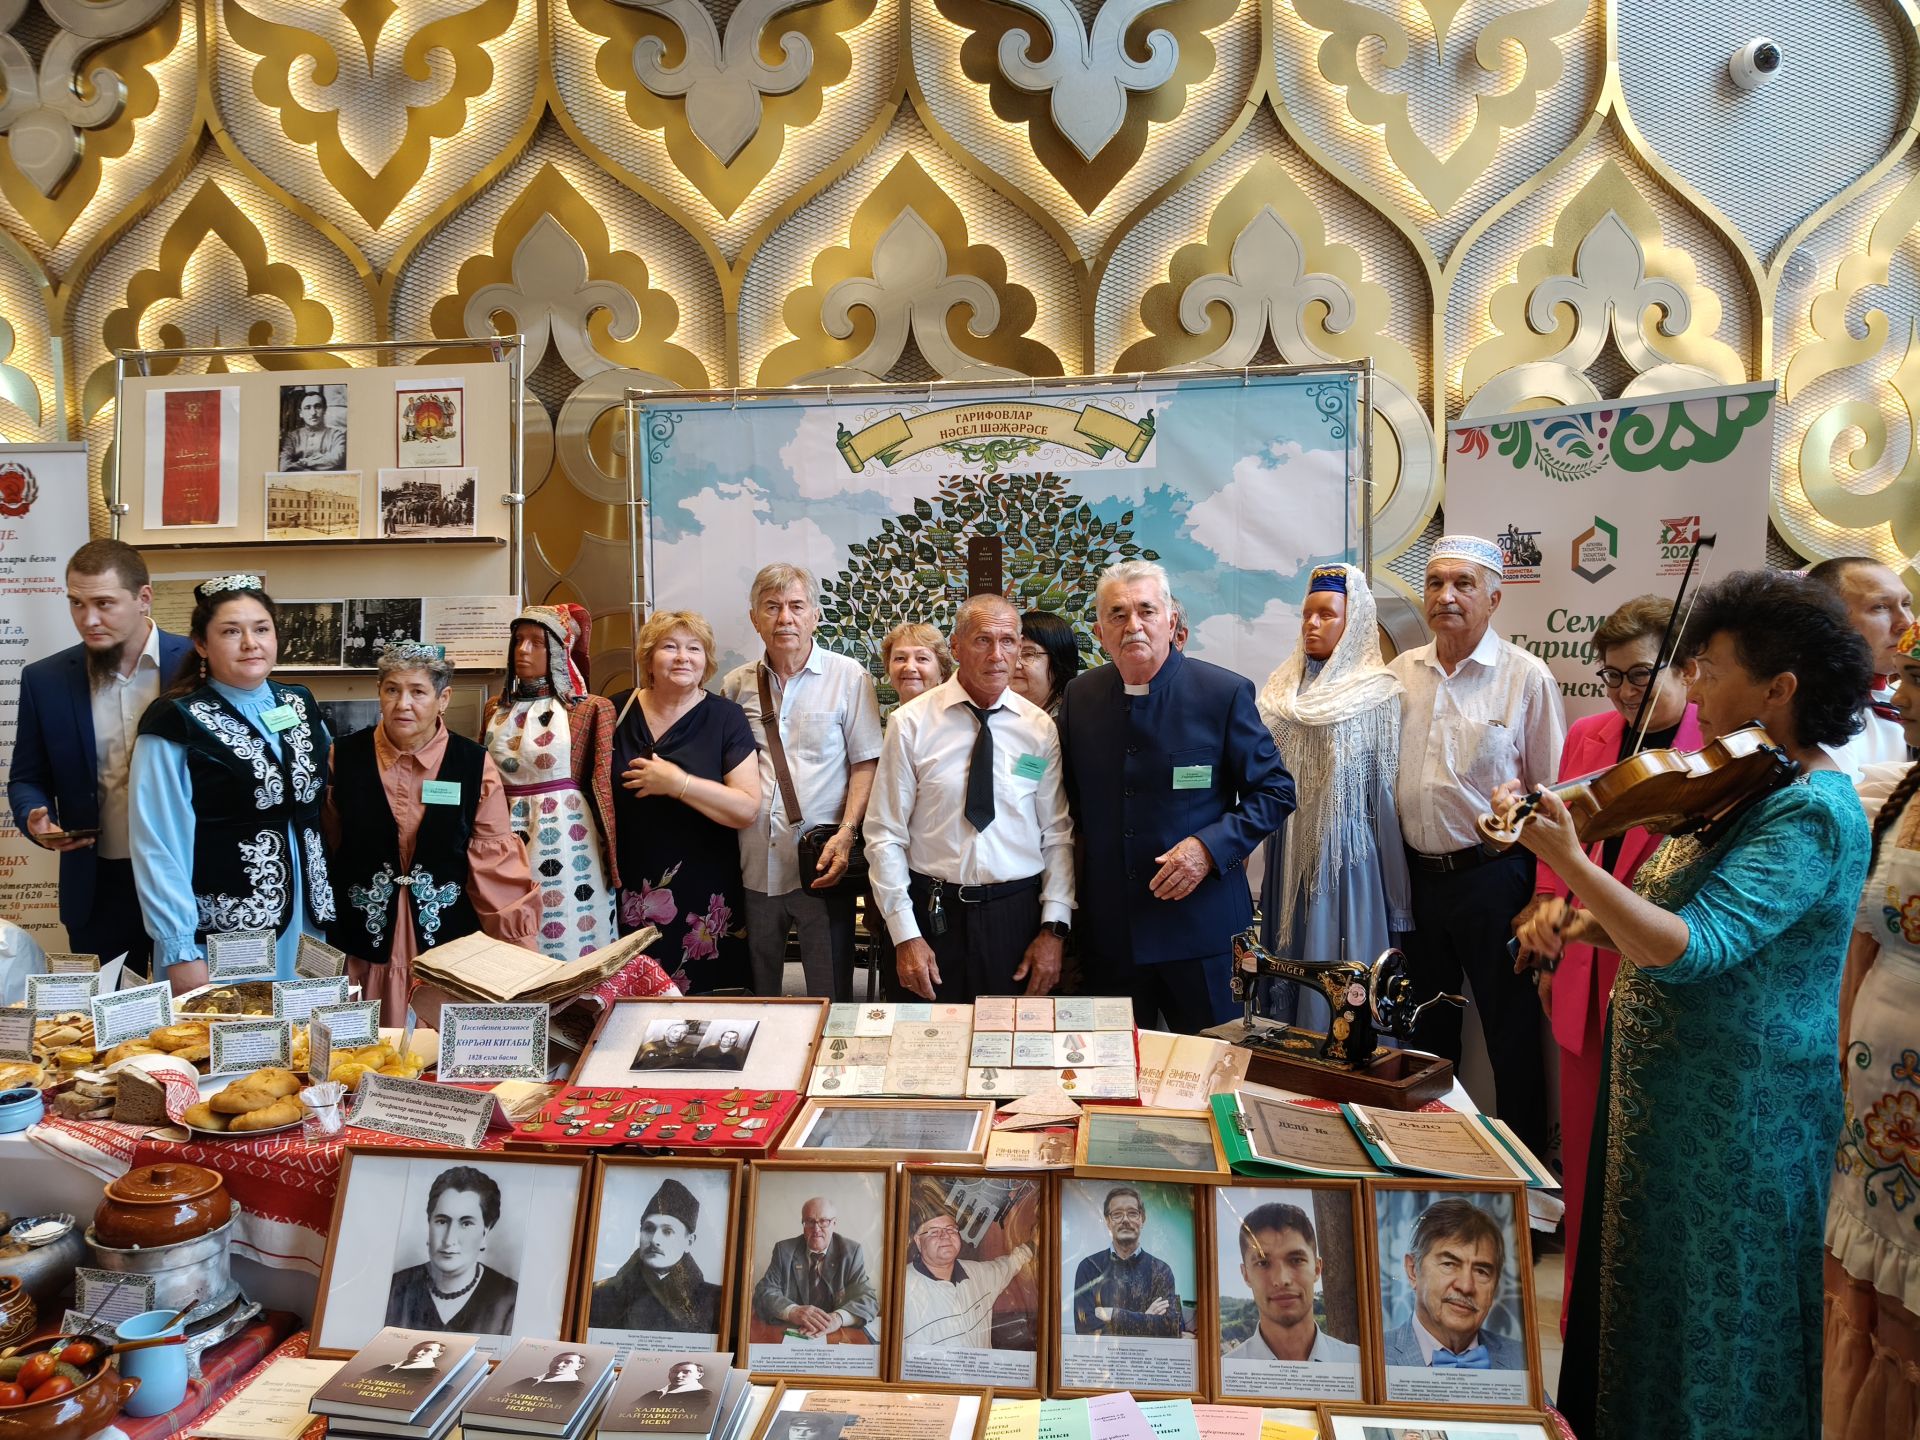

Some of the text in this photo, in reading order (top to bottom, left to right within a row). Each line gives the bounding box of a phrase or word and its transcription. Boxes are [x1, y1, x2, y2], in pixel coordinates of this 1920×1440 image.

[955, 410, 1033, 424] ГАРИФОВЛАР
[940, 423, 1049, 440] НӘСЕЛ ШӘҖӘРӘСЕ
[1497, 537, 1512, 551] 20
[1557, 682, 1610, 698] нск
[15, 891, 43, 901] (1620
[9, 901, 21, 910] 50
[1269, 961, 1305, 976] SINGER
[456, 1038, 531, 1047] КӨРЪӘН КИТАБЫ
[342, 1381, 415, 1396] КАЙТАРЫЛГАН
[359, 1378, 407, 1389] ХАЛЫККА
[358, 1390, 388, 1400] ИСЕМ
[505, 1392, 553, 1403] ХАЛЫККА
[487, 1396, 563, 1410] КАЙТАРЫЛГАН
[505, 1404, 536, 1413] ИСЕМ
[618, 1412, 698, 1420] КАЙТАРЫЛГАН
